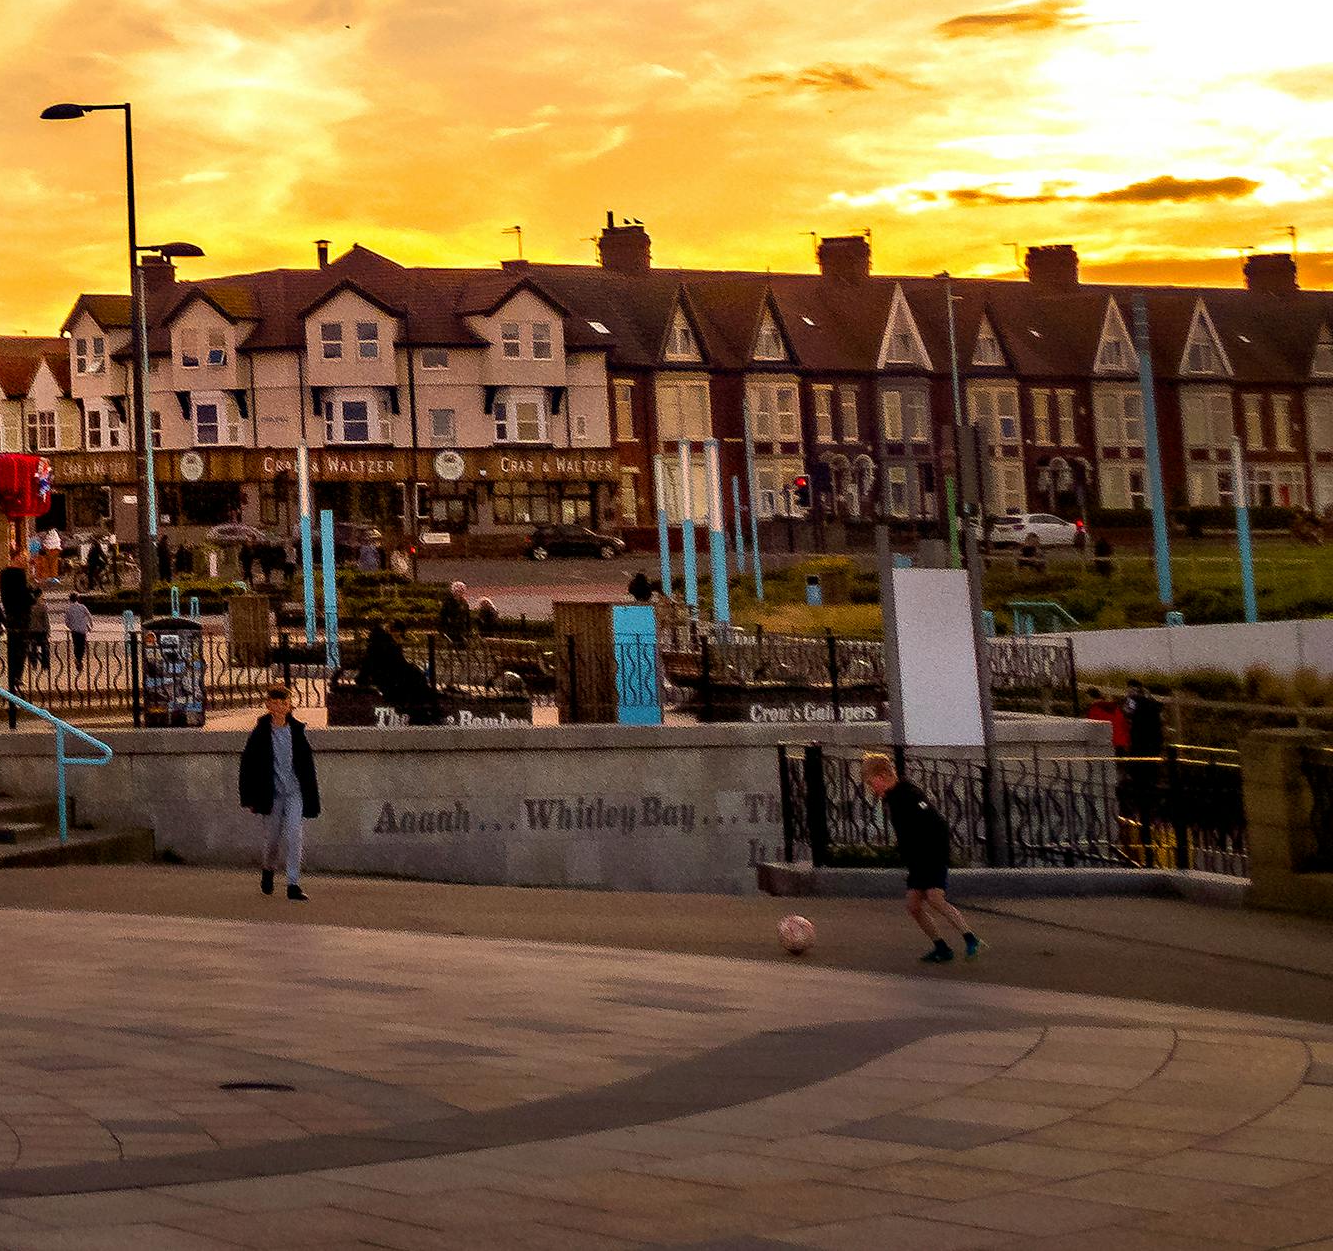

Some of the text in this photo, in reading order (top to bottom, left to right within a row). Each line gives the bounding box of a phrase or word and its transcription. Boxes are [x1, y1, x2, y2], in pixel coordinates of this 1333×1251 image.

[327, 456, 395, 474] WALTZER
[500, 456, 534, 473] CRAB
[556, 456, 613, 474] WALTZER
[523, 797, 635, 836] Whitley
